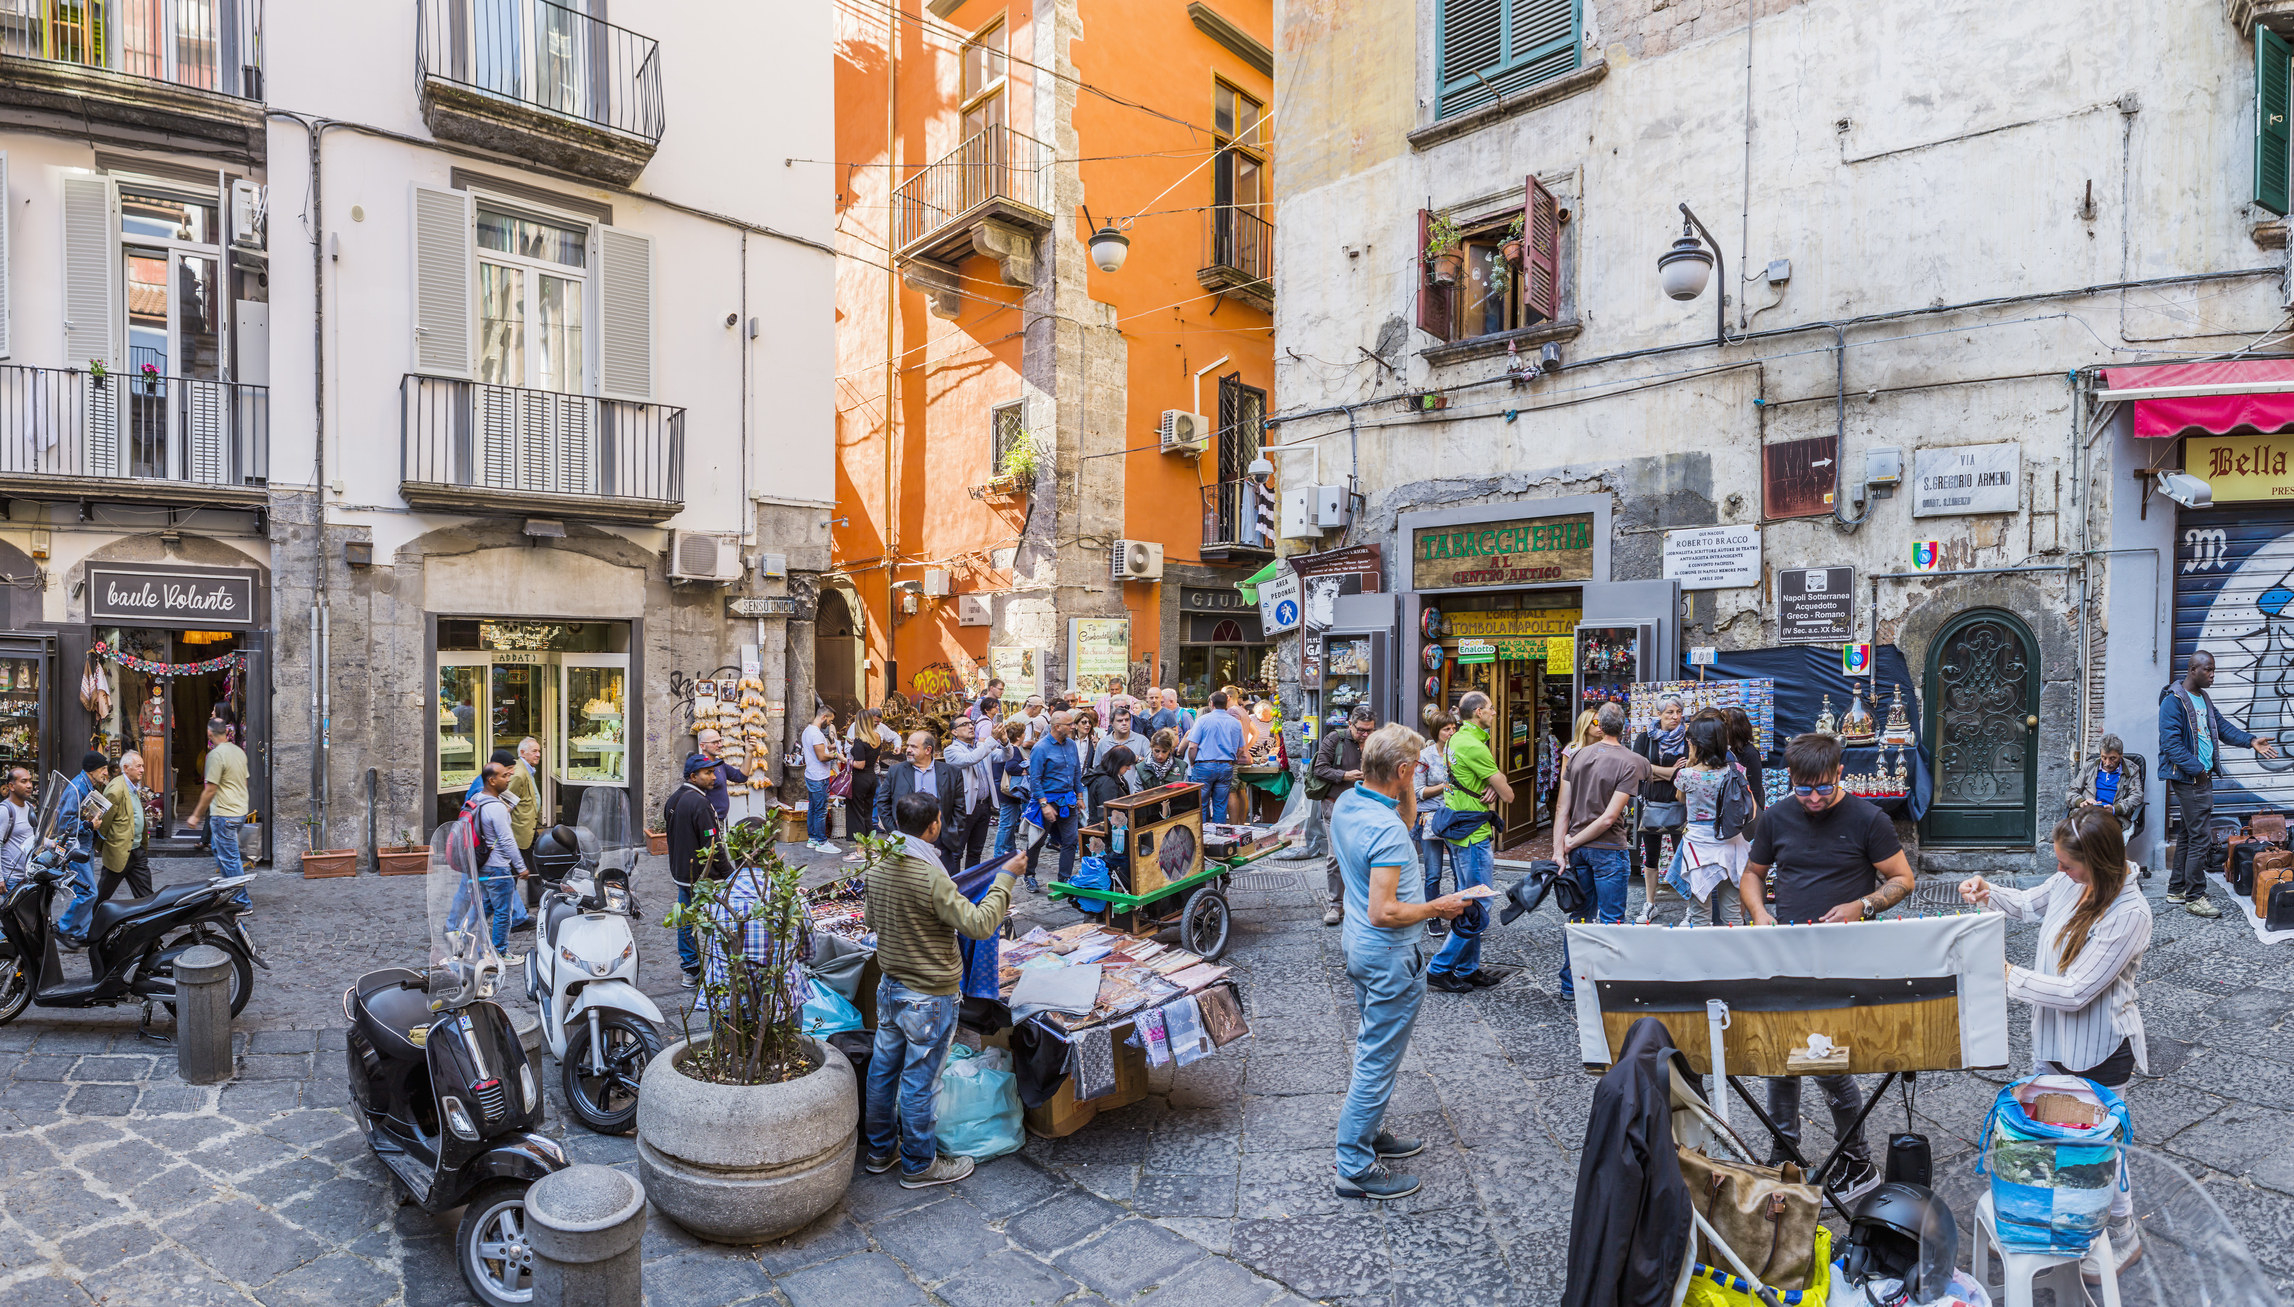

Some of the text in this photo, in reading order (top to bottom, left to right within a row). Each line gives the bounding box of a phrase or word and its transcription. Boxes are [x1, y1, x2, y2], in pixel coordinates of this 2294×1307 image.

[1961, 454, 1975, 466] VIA
[2209, 445, 2288, 480] Bella
[1924, 471, 2011, 491] S.GREGORIO ARMENO
[1677, 536, 1748, 548] ROBERTO BRACCO
[1490, 556, 1513, 568] AL
[1275, 579, 1288, 588] AREA
[107, 581, 235, 611] baule Volante
[1271, 586, 1296, 600] PEDONALE
[1783, 593, 1850, 603] Napoli Sotterranea
[744, 601, 794, 612] SENSO UNICO
[1795, 602, 1837, 611] Acquedotto
[1486, 610, 1546, 620] L'ORIGINALE
[1815, 611, 1846, 619] Romano
[1452, 622, 1505, 635] TOMBOLA
[1783, 628, 1792, 636] (IV
